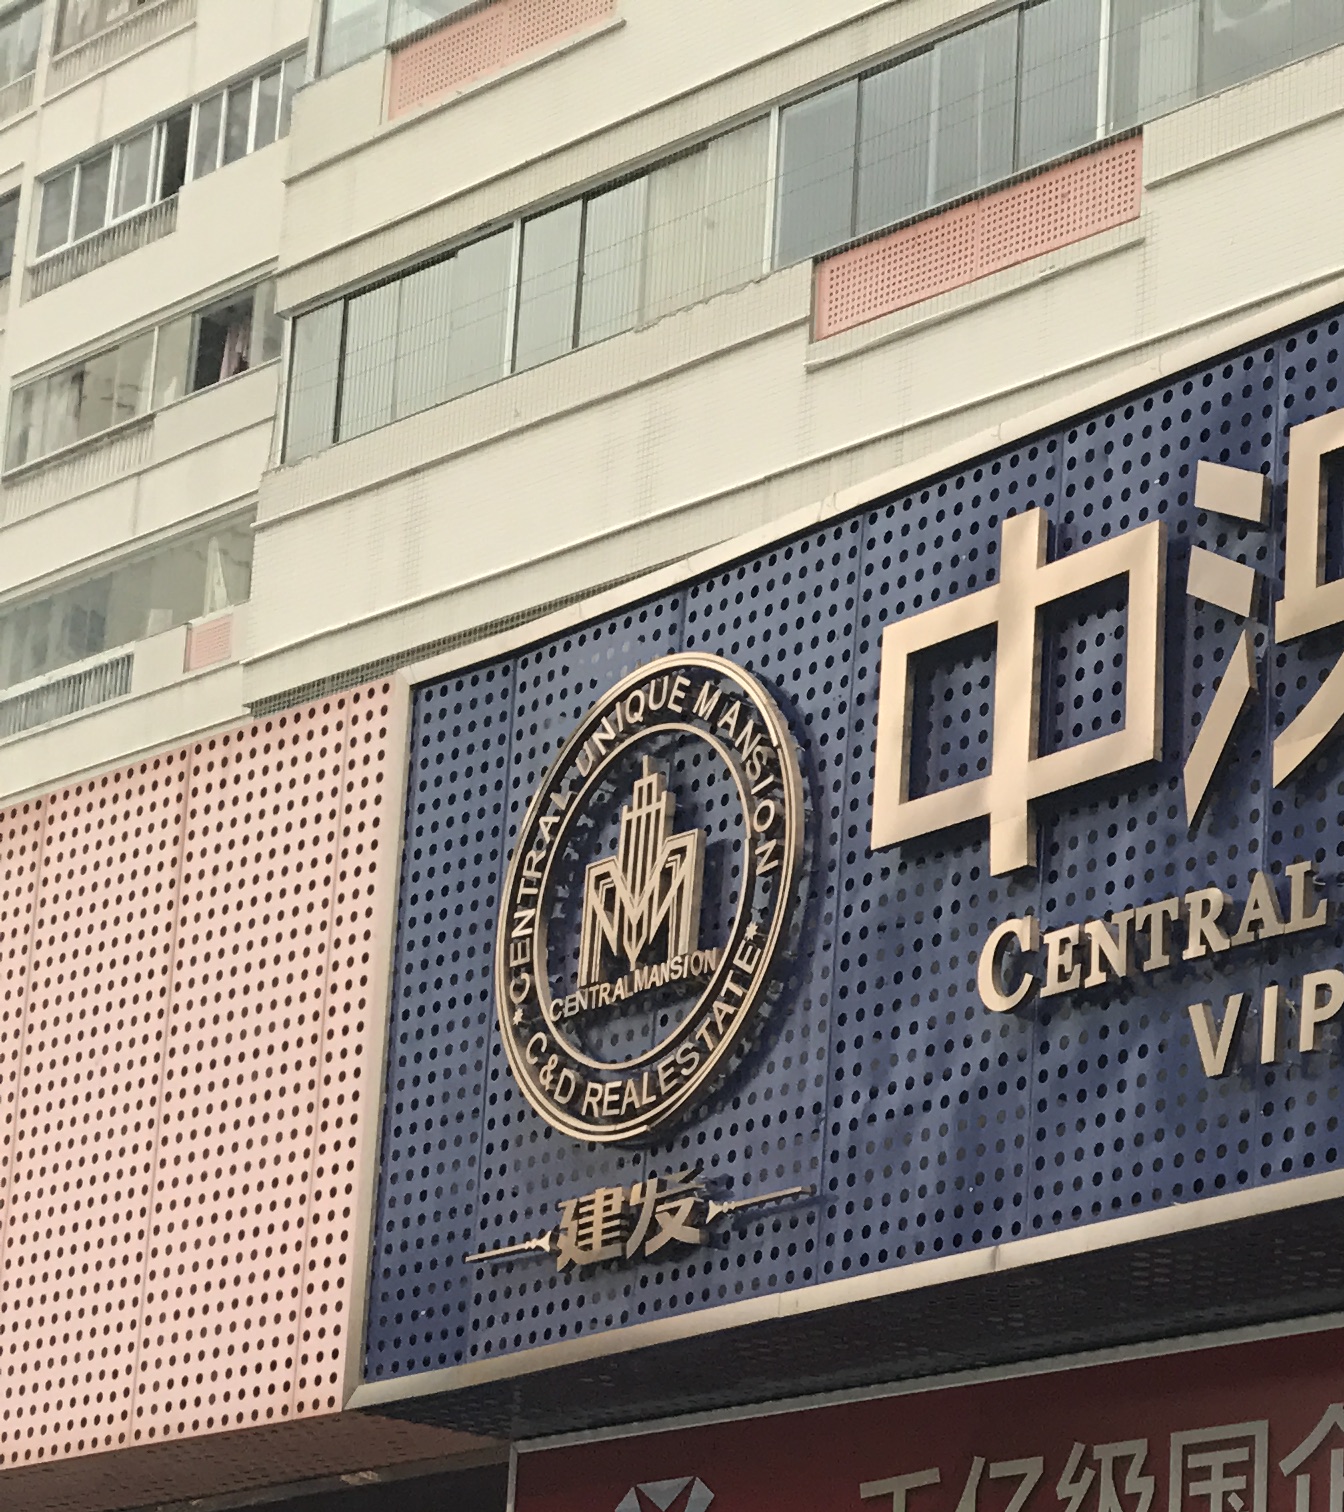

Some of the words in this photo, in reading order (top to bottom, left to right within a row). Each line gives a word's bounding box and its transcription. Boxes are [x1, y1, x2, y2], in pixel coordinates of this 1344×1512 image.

[509, 790, 578, 1004] CENTRAL
[575, 676, 690, 777] UNIQUE
[693, 681, 779, 875] MANSION
[977, 862, 1328, 1013] CENTRAL
[556, 1167, 708, 1273] 建发
